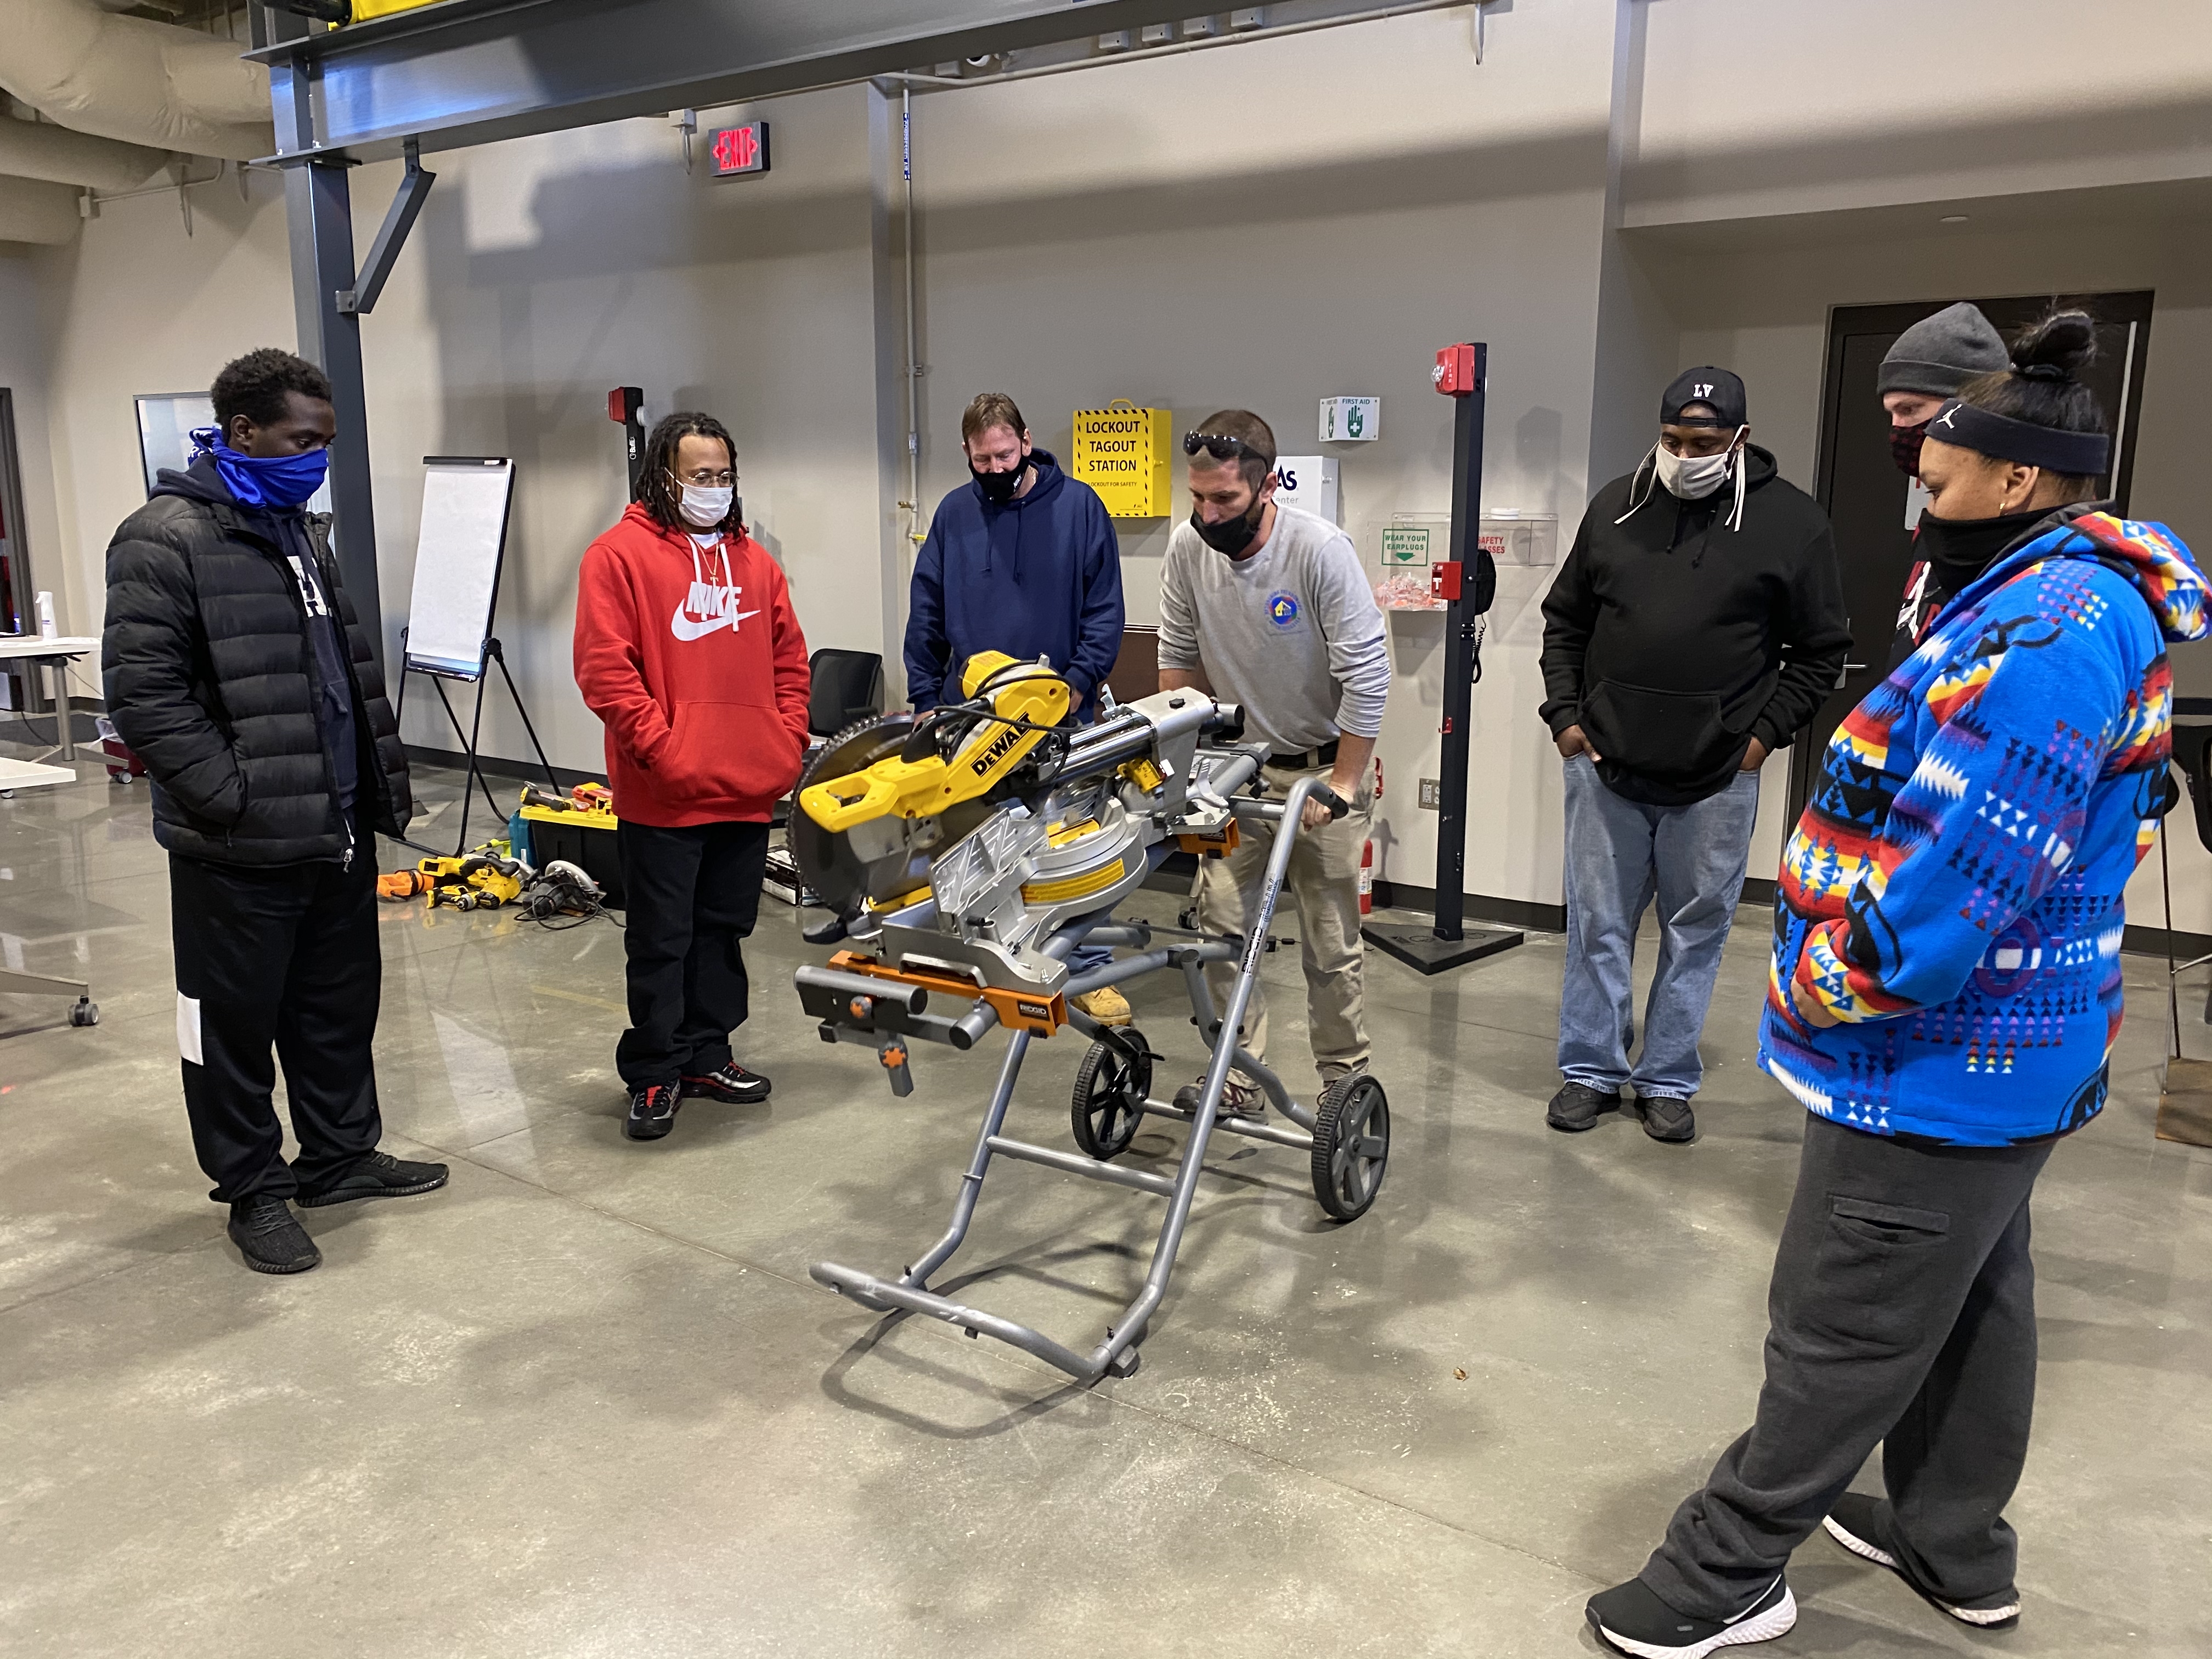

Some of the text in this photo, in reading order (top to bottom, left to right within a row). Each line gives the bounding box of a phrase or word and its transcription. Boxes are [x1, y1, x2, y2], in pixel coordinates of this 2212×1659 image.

[718, 127, 752, 170] EXIT
[1086, 421, 1141, 433] LOCKOUT
[1089, 440, 1137, 453] TAGOUT
[1088, 459, 1137, 472] STATION
[1273, 495, 1299, 504] enter
[685, 581, 742, 617] NIKE
